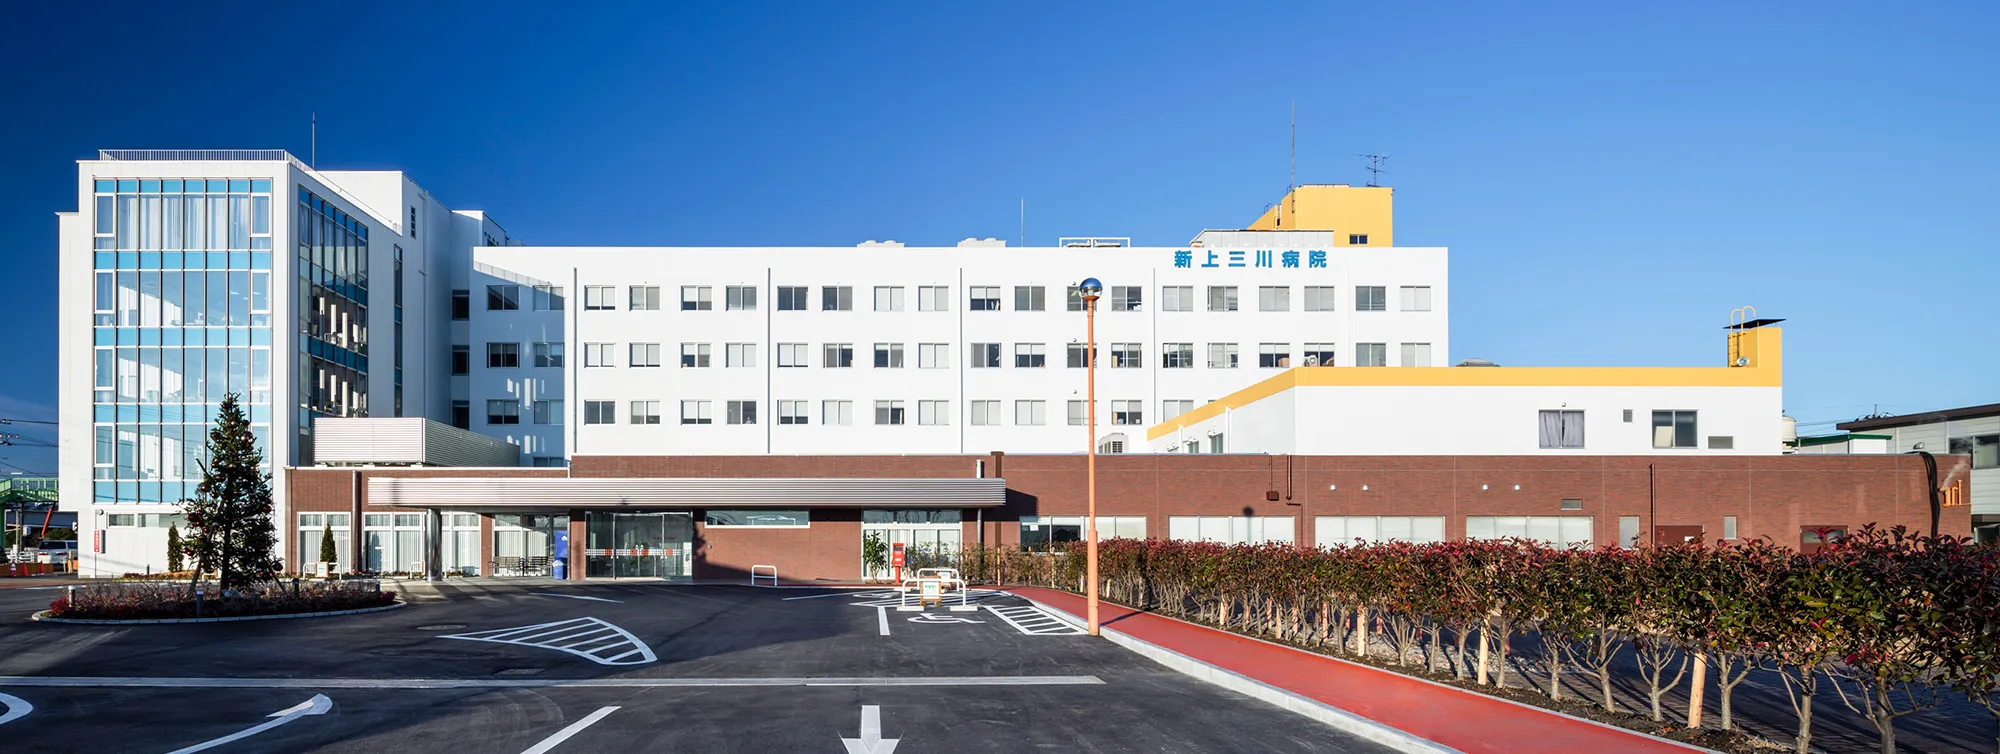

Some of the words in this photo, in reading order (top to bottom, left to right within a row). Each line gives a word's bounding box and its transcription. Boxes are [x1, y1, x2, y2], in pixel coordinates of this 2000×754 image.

[1174, 250, 1327, 268] 新上三川病院
